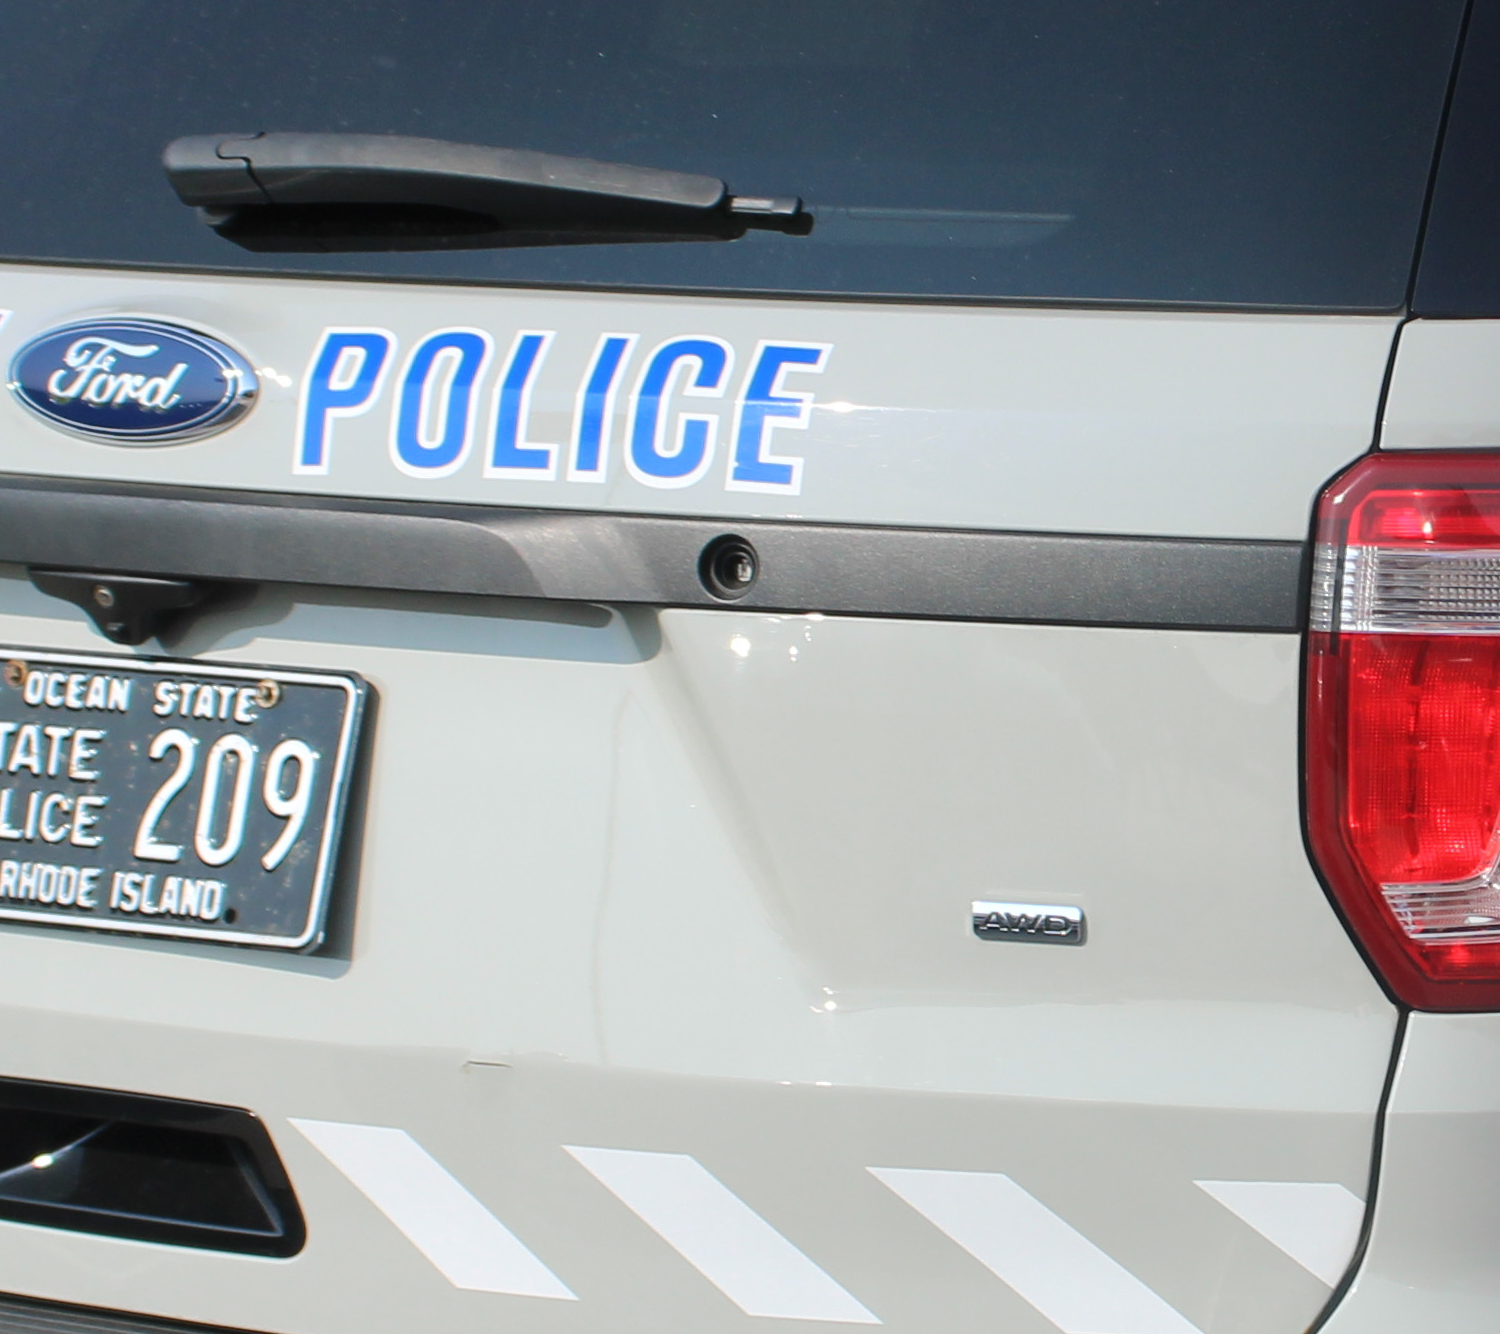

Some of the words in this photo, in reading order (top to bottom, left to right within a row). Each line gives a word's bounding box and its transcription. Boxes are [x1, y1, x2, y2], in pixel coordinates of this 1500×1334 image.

[47, 335, 189, 410] Ford
[293, 324, 835, 496] POLICE
[23, 670, 132, 712] OCEAN
[152, 680, 258, 724] STATE
[133, 728, 321, 871] 209
[110, 870, 227, 922] ISLAND
[978, 910, 1073, 937] AWD
